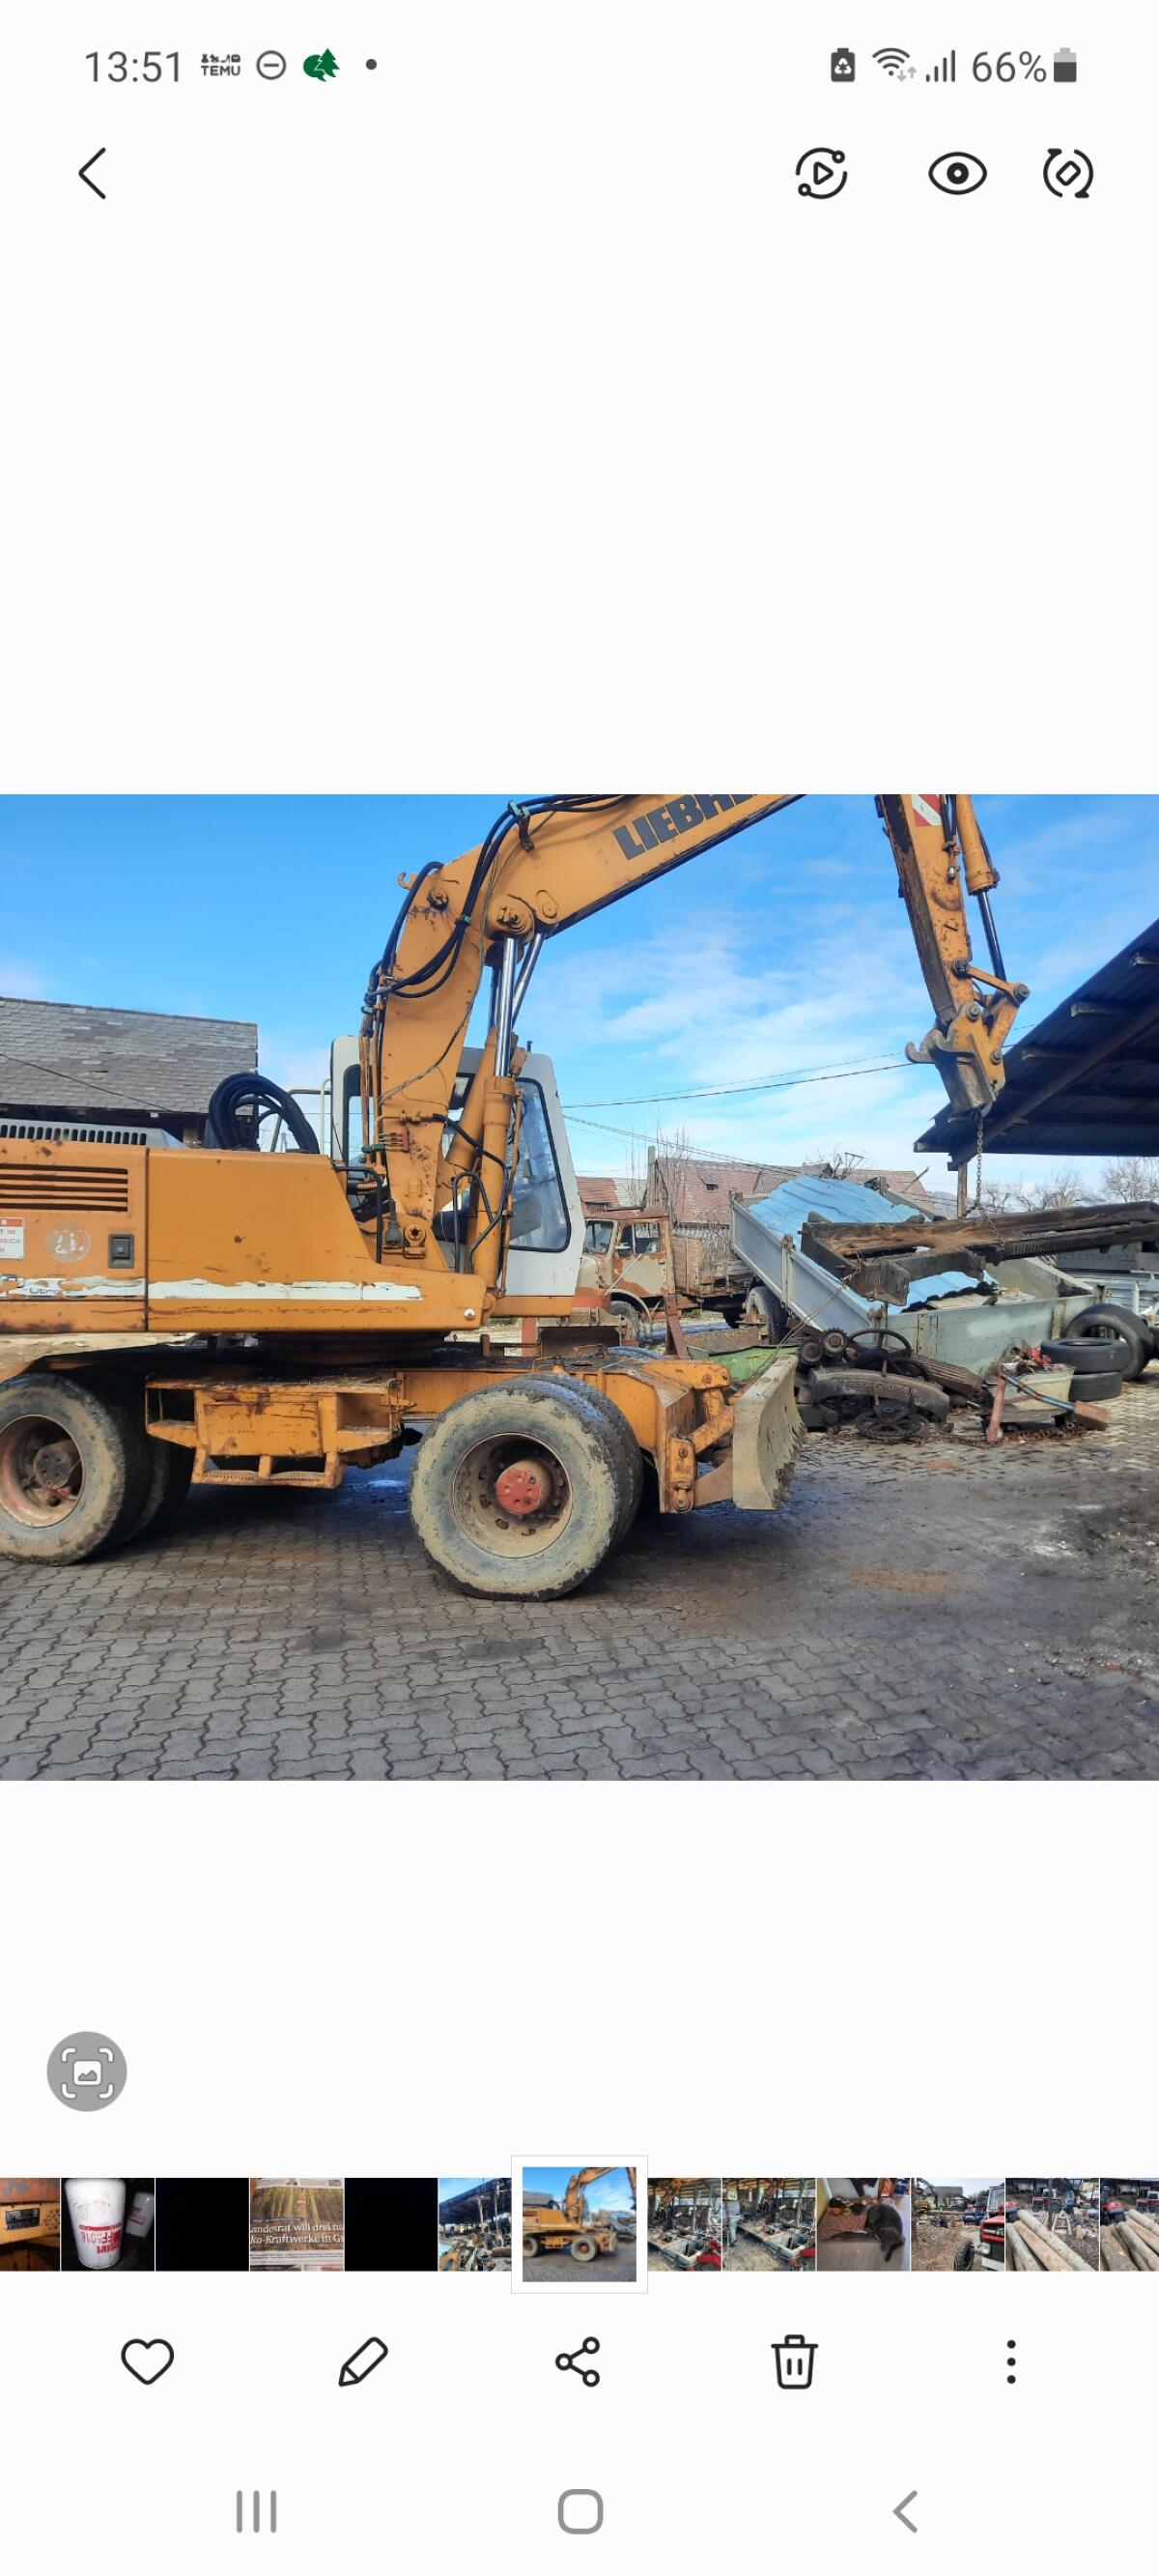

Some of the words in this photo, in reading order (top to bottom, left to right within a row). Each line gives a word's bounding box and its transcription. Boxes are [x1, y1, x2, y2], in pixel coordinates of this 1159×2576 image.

[85, 50, 181, 83] 13:51
[200, 65, 241, 76] TEMU
[972, 50, 1048, 83] 66%
[612, 794, 757, 861] LIEBH
[250, 2233, 321, 2245] ko-Kraftwerke
